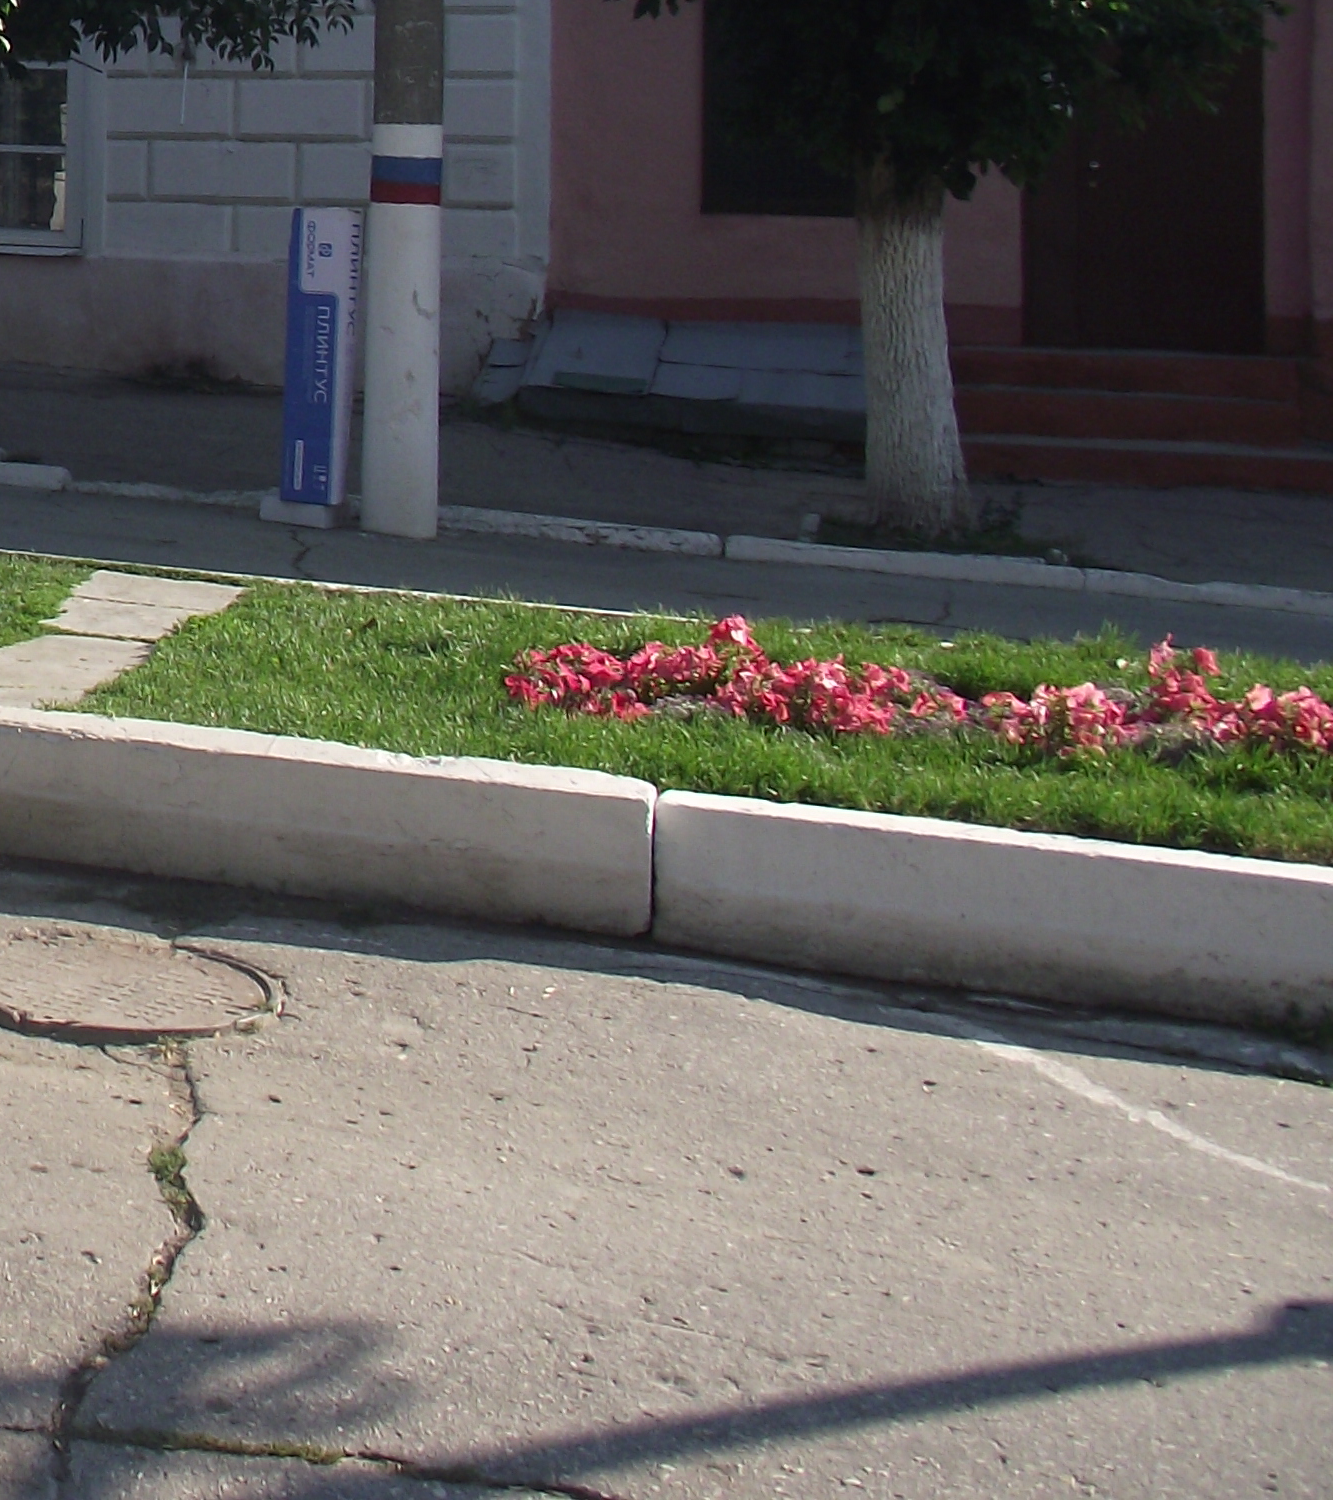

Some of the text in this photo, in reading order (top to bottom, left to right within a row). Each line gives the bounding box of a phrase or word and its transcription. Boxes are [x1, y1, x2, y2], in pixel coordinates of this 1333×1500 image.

[306, 220, 317, 279] ФОРМАТ
[346, 223, 360, 337] ПЛИНТУС
[314, 305, 331, 404] ПЛИНТУС
